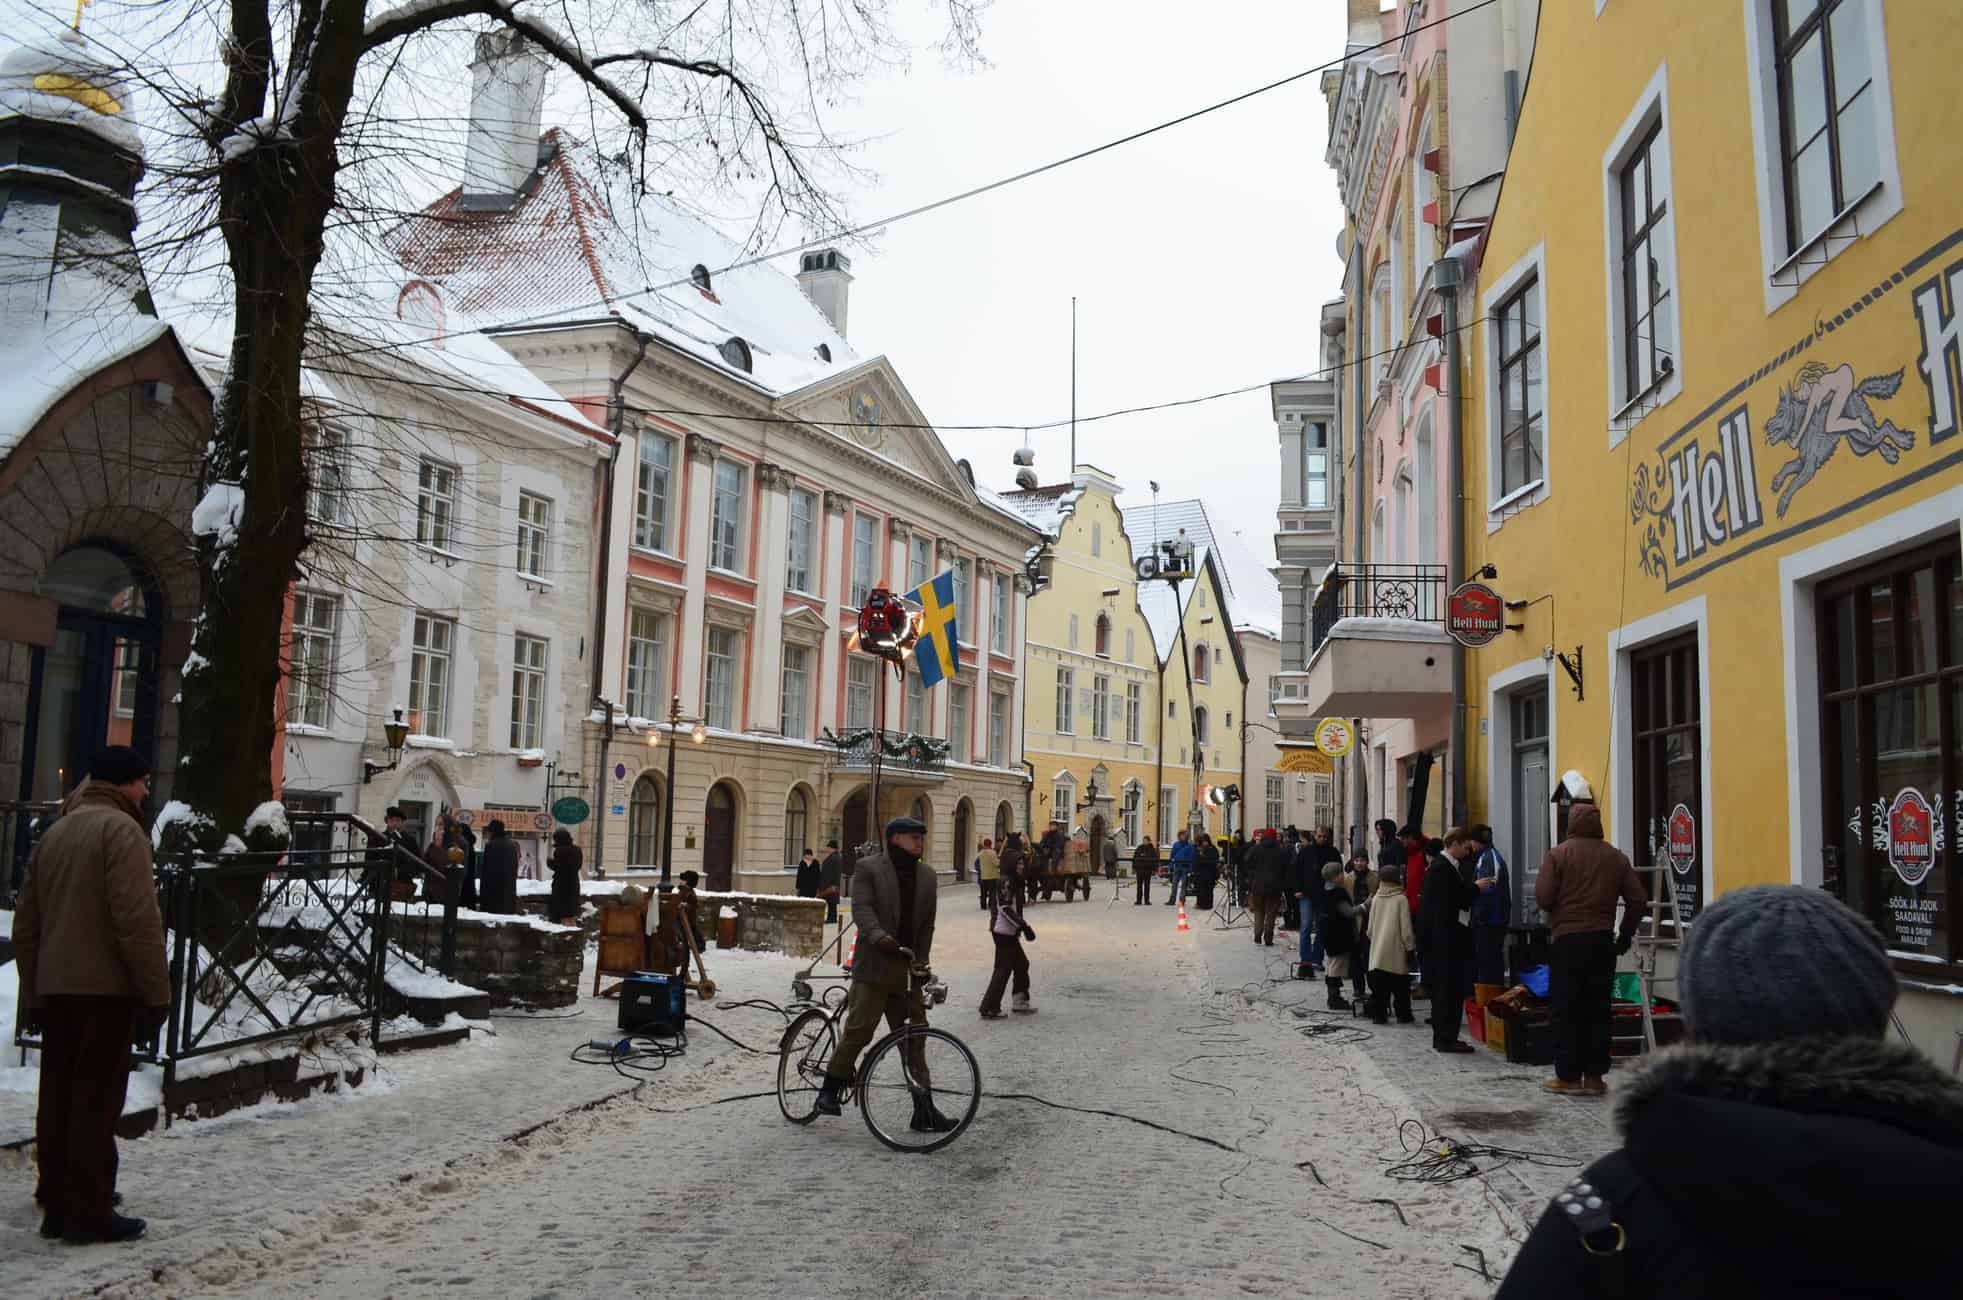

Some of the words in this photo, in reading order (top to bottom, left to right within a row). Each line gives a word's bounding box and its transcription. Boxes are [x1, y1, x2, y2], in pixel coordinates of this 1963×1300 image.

[1667, 402, 1763, 567] Hell
[1453, 616, 1473, 629] Hell
[1475, 617, 1498, 630] Hunt
[1894, 840, 1909, 856] Hell
[1910, 841, 1928, 856] Hunt
